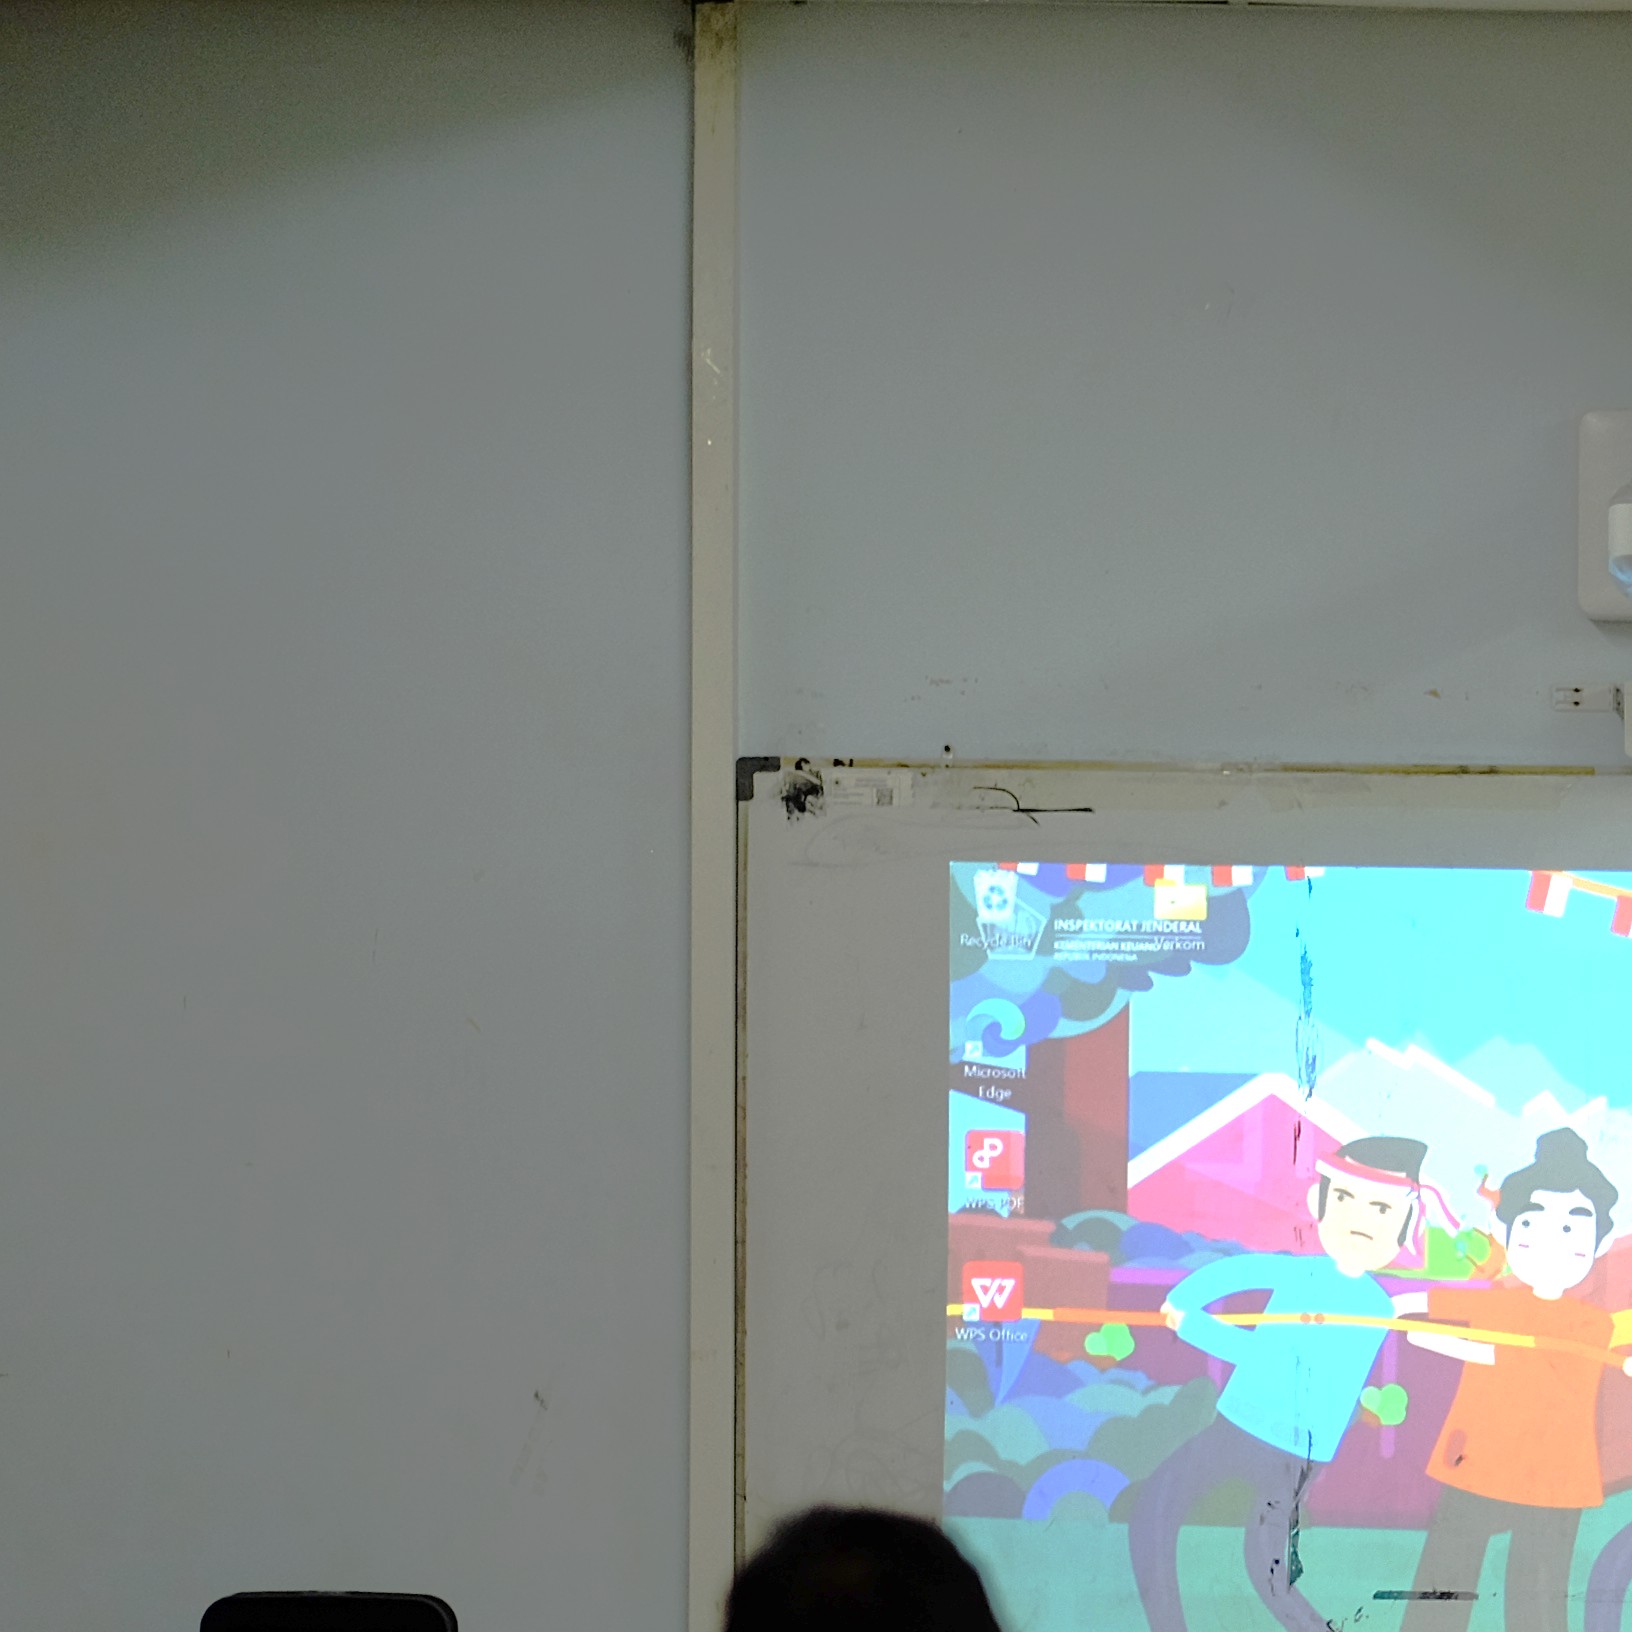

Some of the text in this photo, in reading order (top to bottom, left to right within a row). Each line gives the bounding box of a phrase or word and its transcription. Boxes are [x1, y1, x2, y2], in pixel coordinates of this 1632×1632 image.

[1054, 919, 1202, 933] INSPEKTORAT JENDERAL
[1054, 940, 1118, 951] KEMENTERIAN
[1154, 936, 1205, 951] Verkom
[963, 1064, 1026, 1079] Microsoft
[979, 1085, 1012, 1101] Edge
[955, 1327, 1028, 1341] WPS Office
